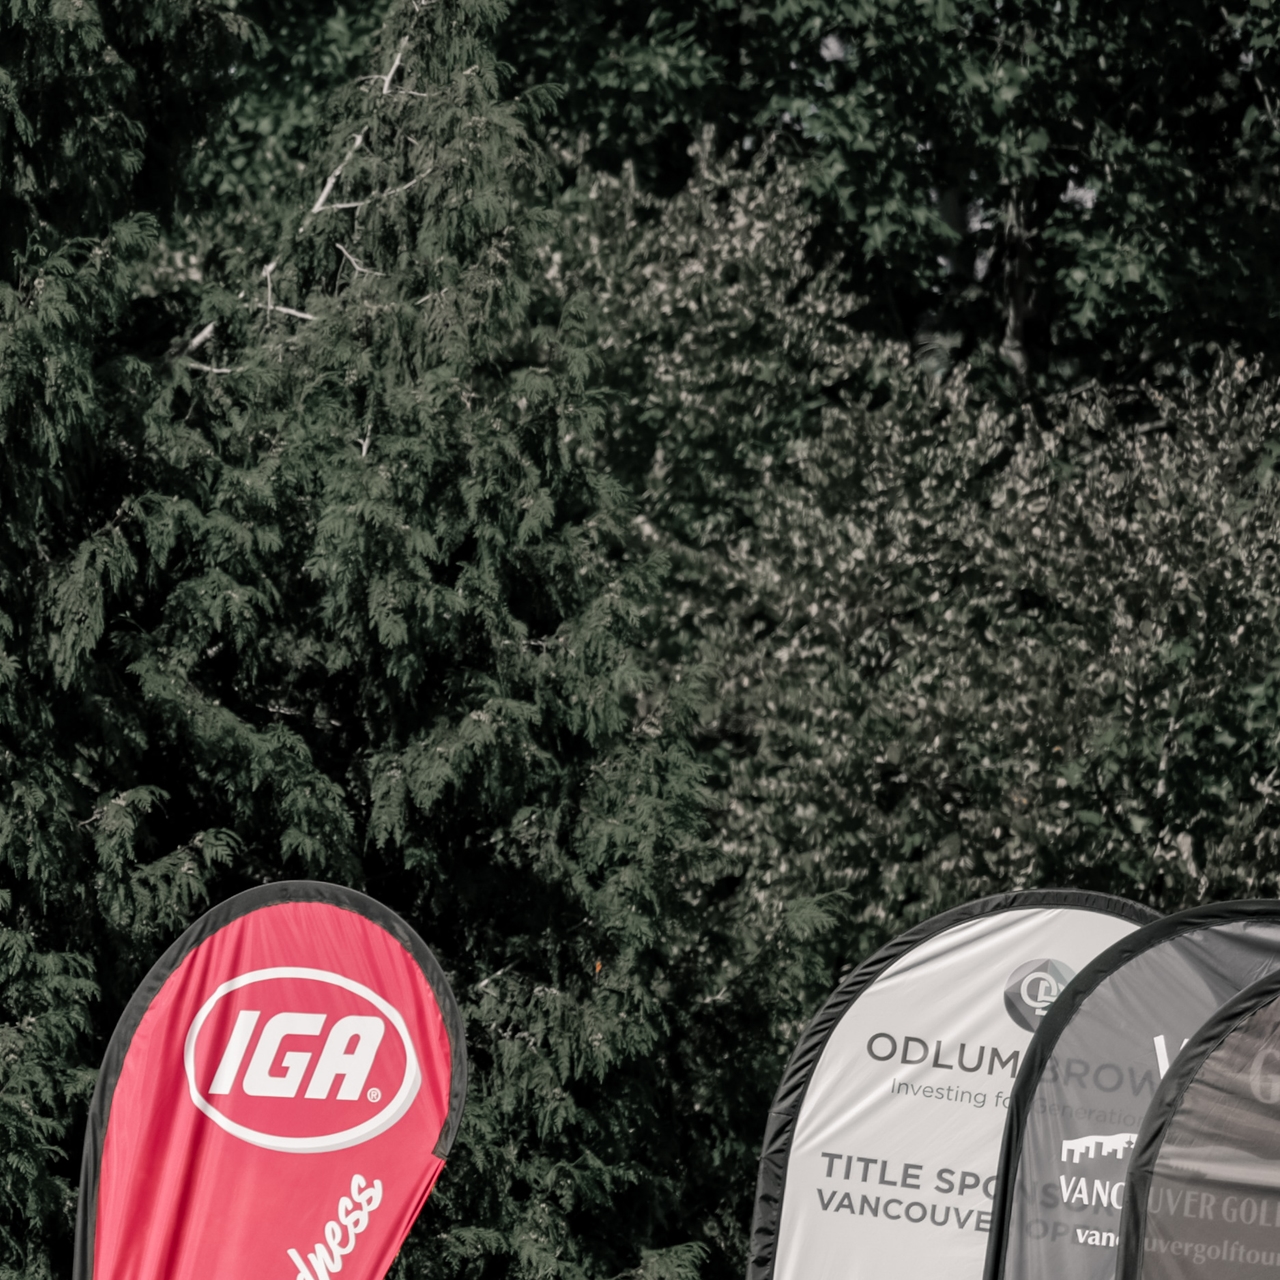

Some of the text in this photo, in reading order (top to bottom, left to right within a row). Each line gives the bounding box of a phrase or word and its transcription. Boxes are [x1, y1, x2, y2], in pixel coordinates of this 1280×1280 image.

[208, 1010, 385, 1101] IGA
[866, 1032, 1159, 1097] ODLUM BROW
[890, 1077, 1141, 1128] Investing fo Generatio
[821, 1151, 923, 1190] TITLE
[1059, 1174, 1214, 1220] VANCUVER
[816, 1188, 1114, 1248] VANCOUVE OPE
